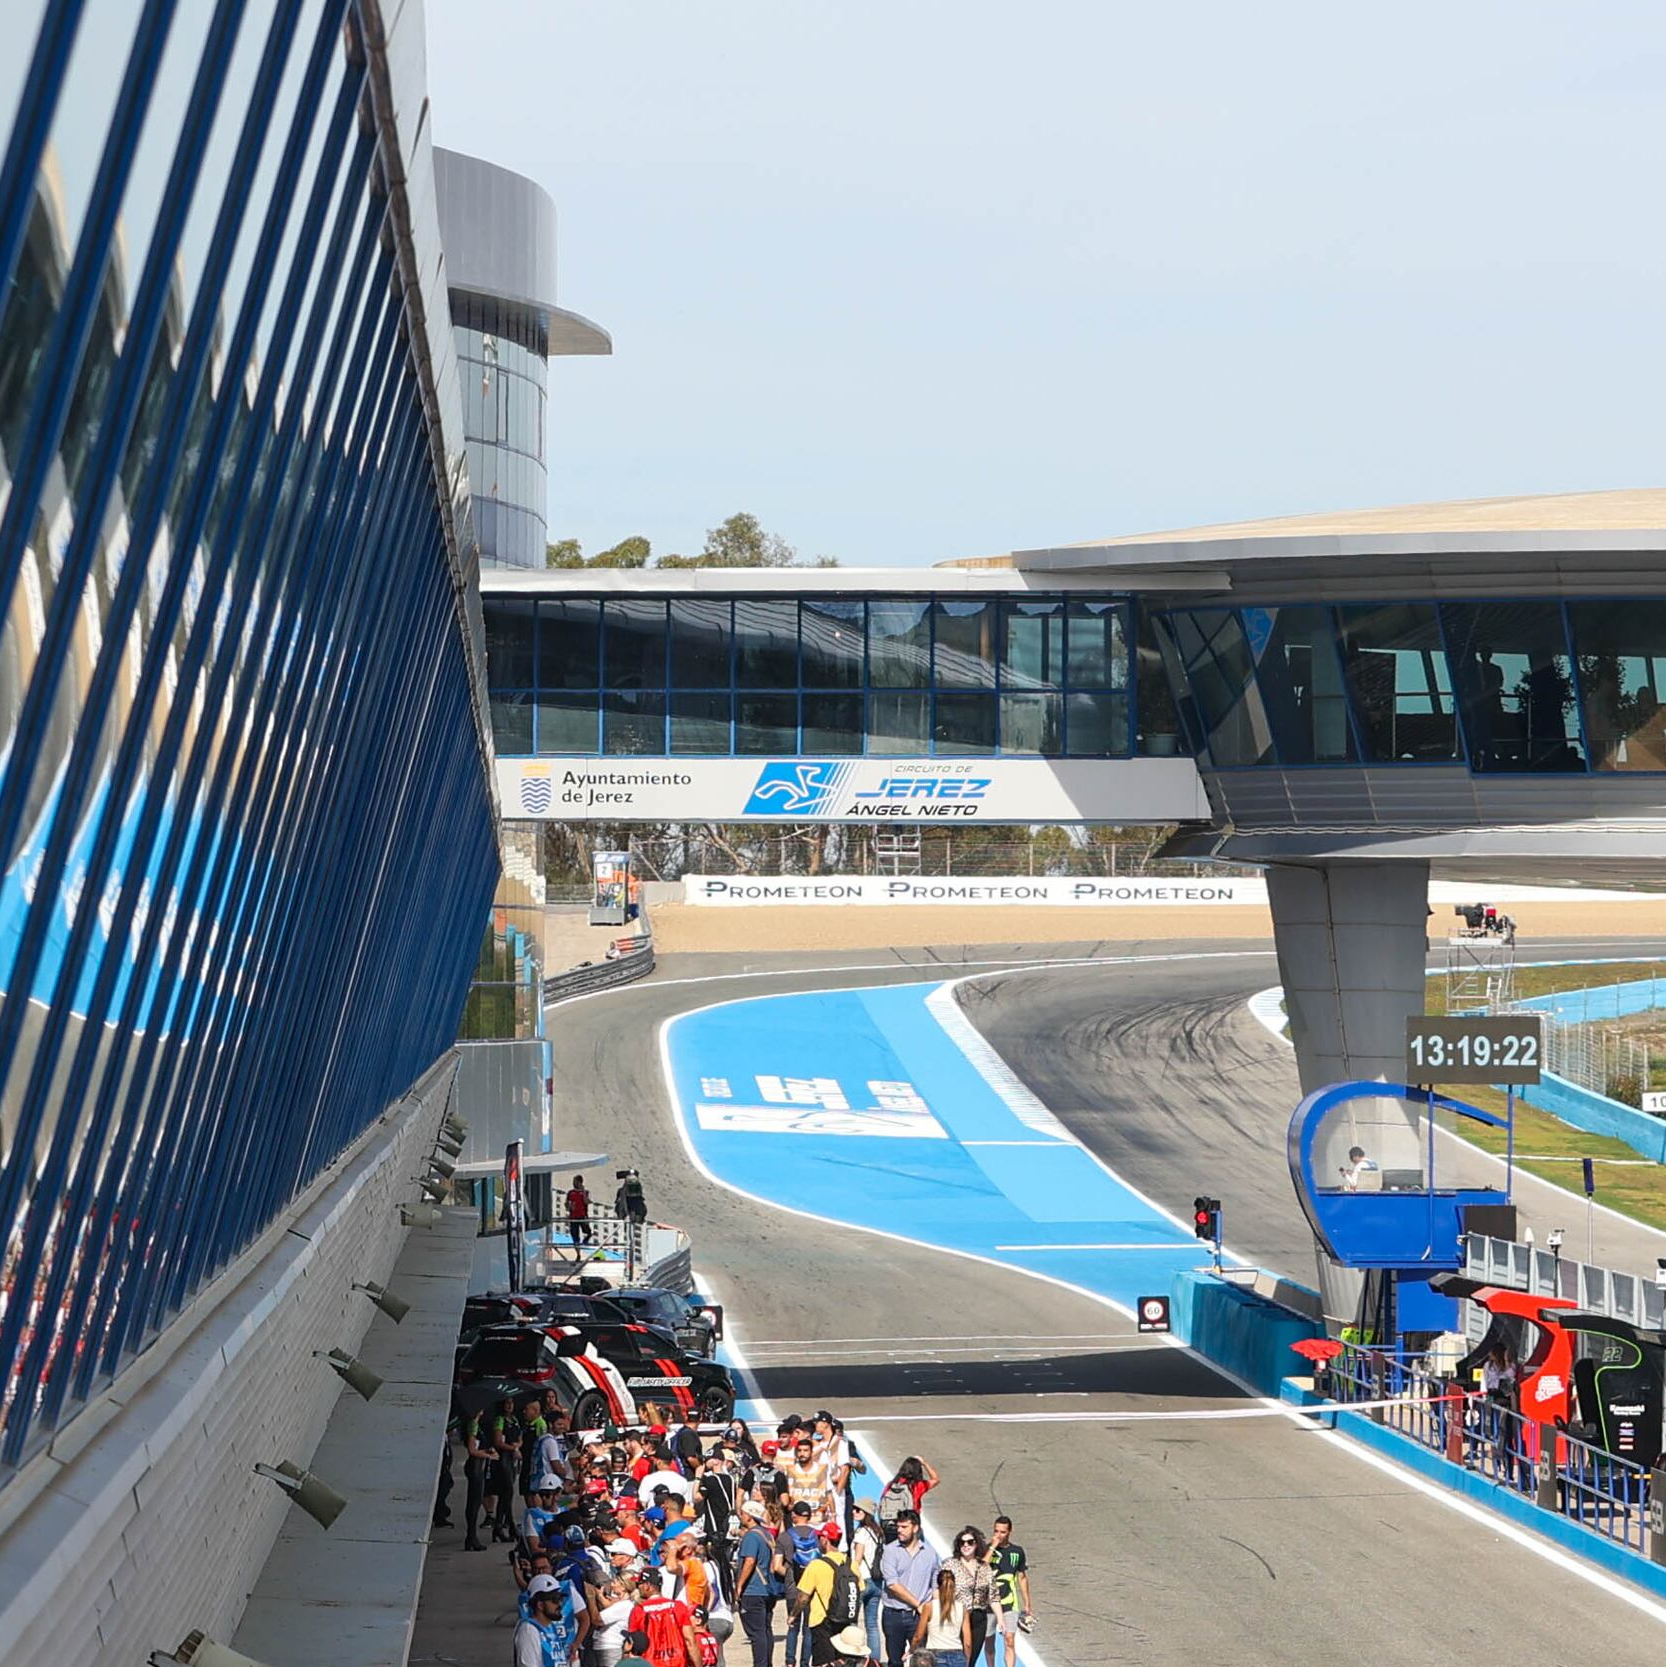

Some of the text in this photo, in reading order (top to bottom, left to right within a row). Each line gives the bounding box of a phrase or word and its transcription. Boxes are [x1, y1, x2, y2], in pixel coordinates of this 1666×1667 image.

[894, 765, 973, 773] CIRCUITO DE
[562, 770, 692, 787] Ayuntamiento
[562, 788, 634, 806] de Jerez
[855, 778, 992, 798] JEREZ
[845, 802, 979, 816] ÁNGEL NIETO
[703, 881, 863, 899] PROMETEON
[885, 882, 1048, 900] PROMETEON
[1073, 883, 1233, 901] PROMETEON
[1410, 1035, 1537, 1067] 13:19:22
[847, 1581, 857, 1619] adidas
